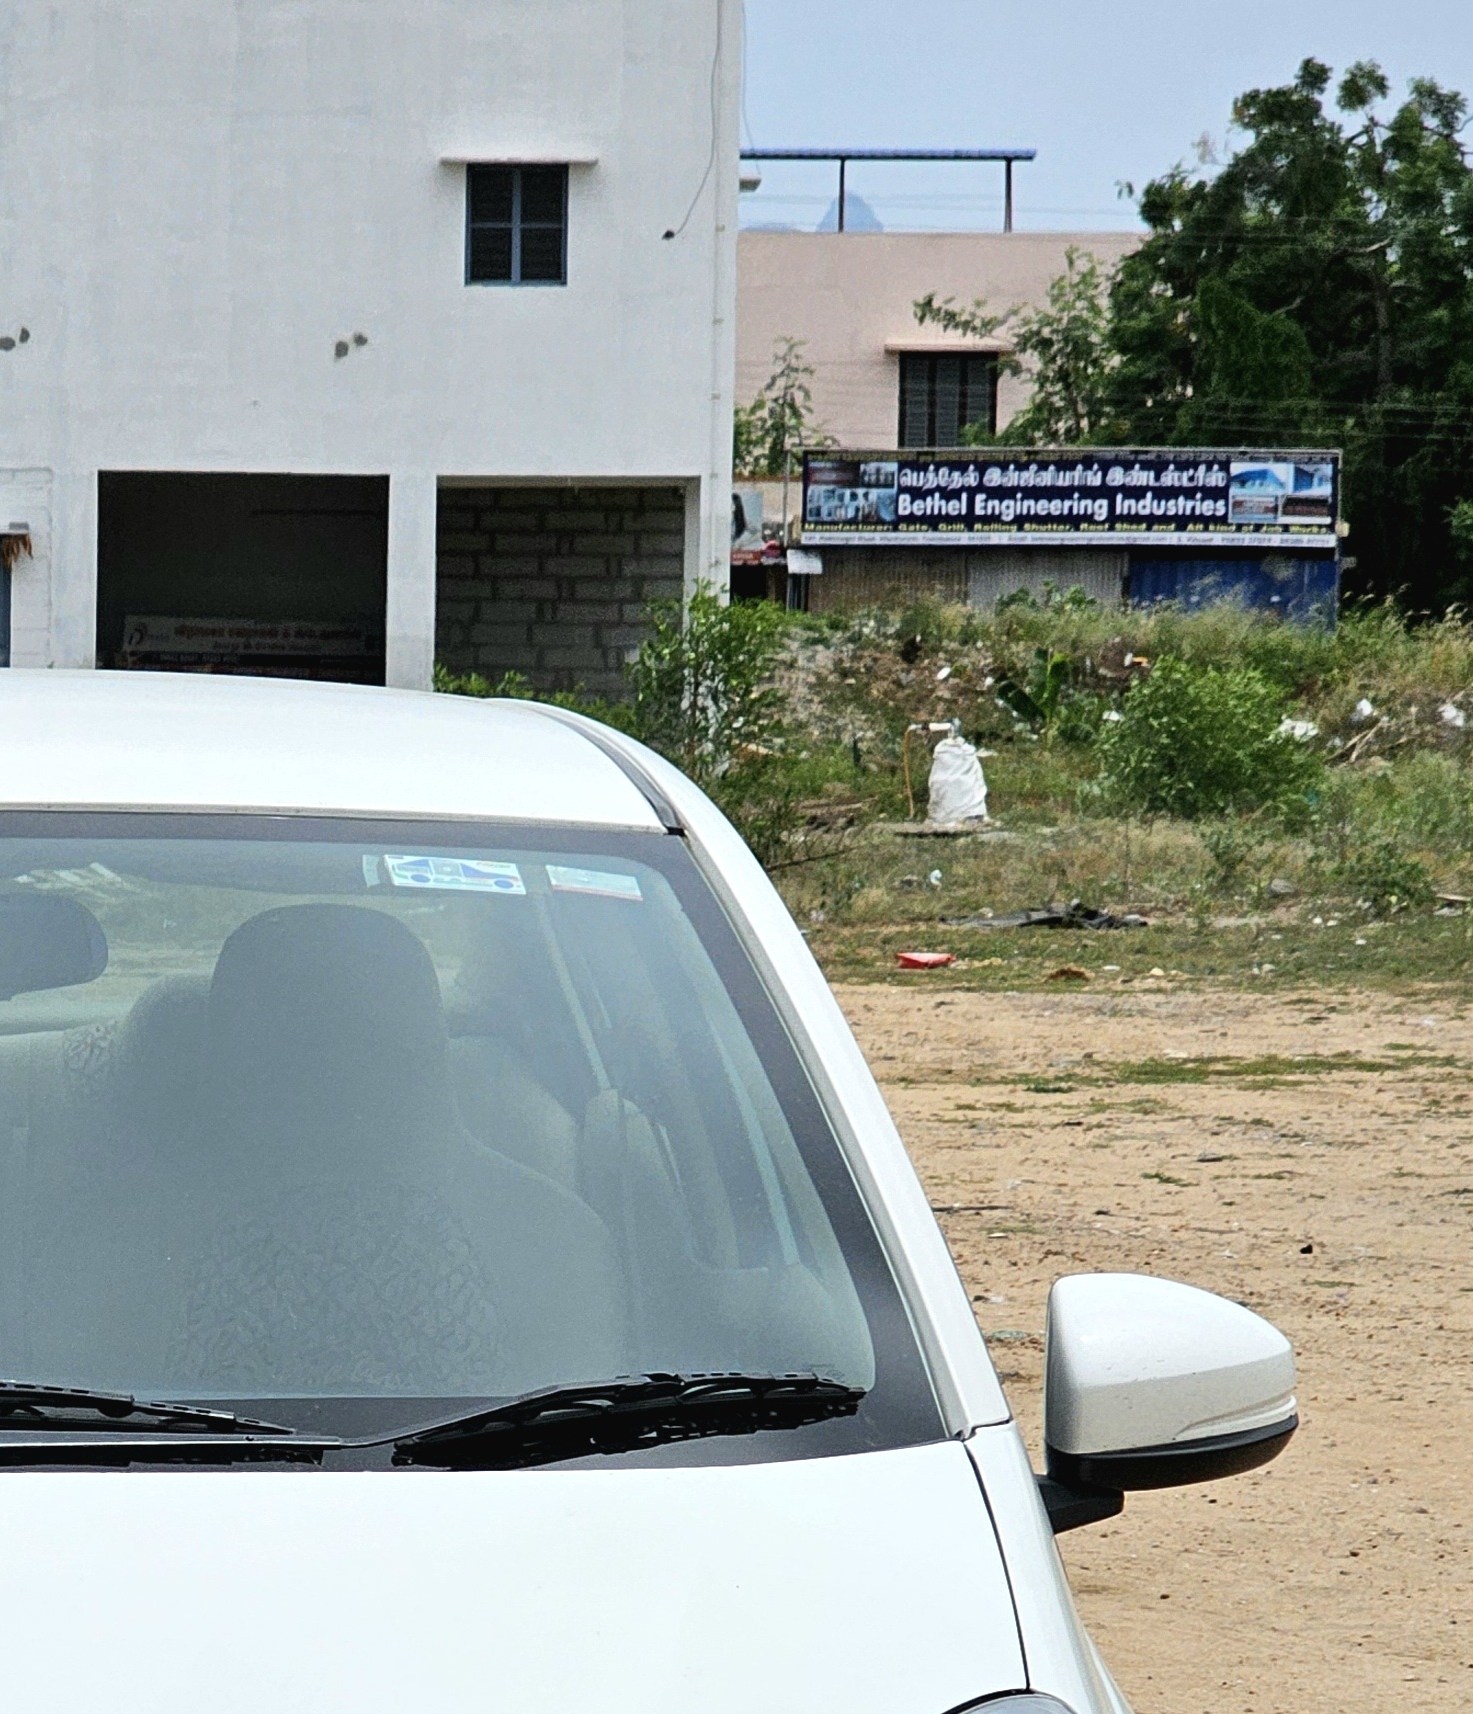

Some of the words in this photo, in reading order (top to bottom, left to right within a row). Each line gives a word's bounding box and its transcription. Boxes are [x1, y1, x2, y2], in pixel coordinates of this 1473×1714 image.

[898, 492, 968, 516] Bethel
[974, 492, 1109, 522] Engineering
[1115, 490, 1227, 516] Industries
